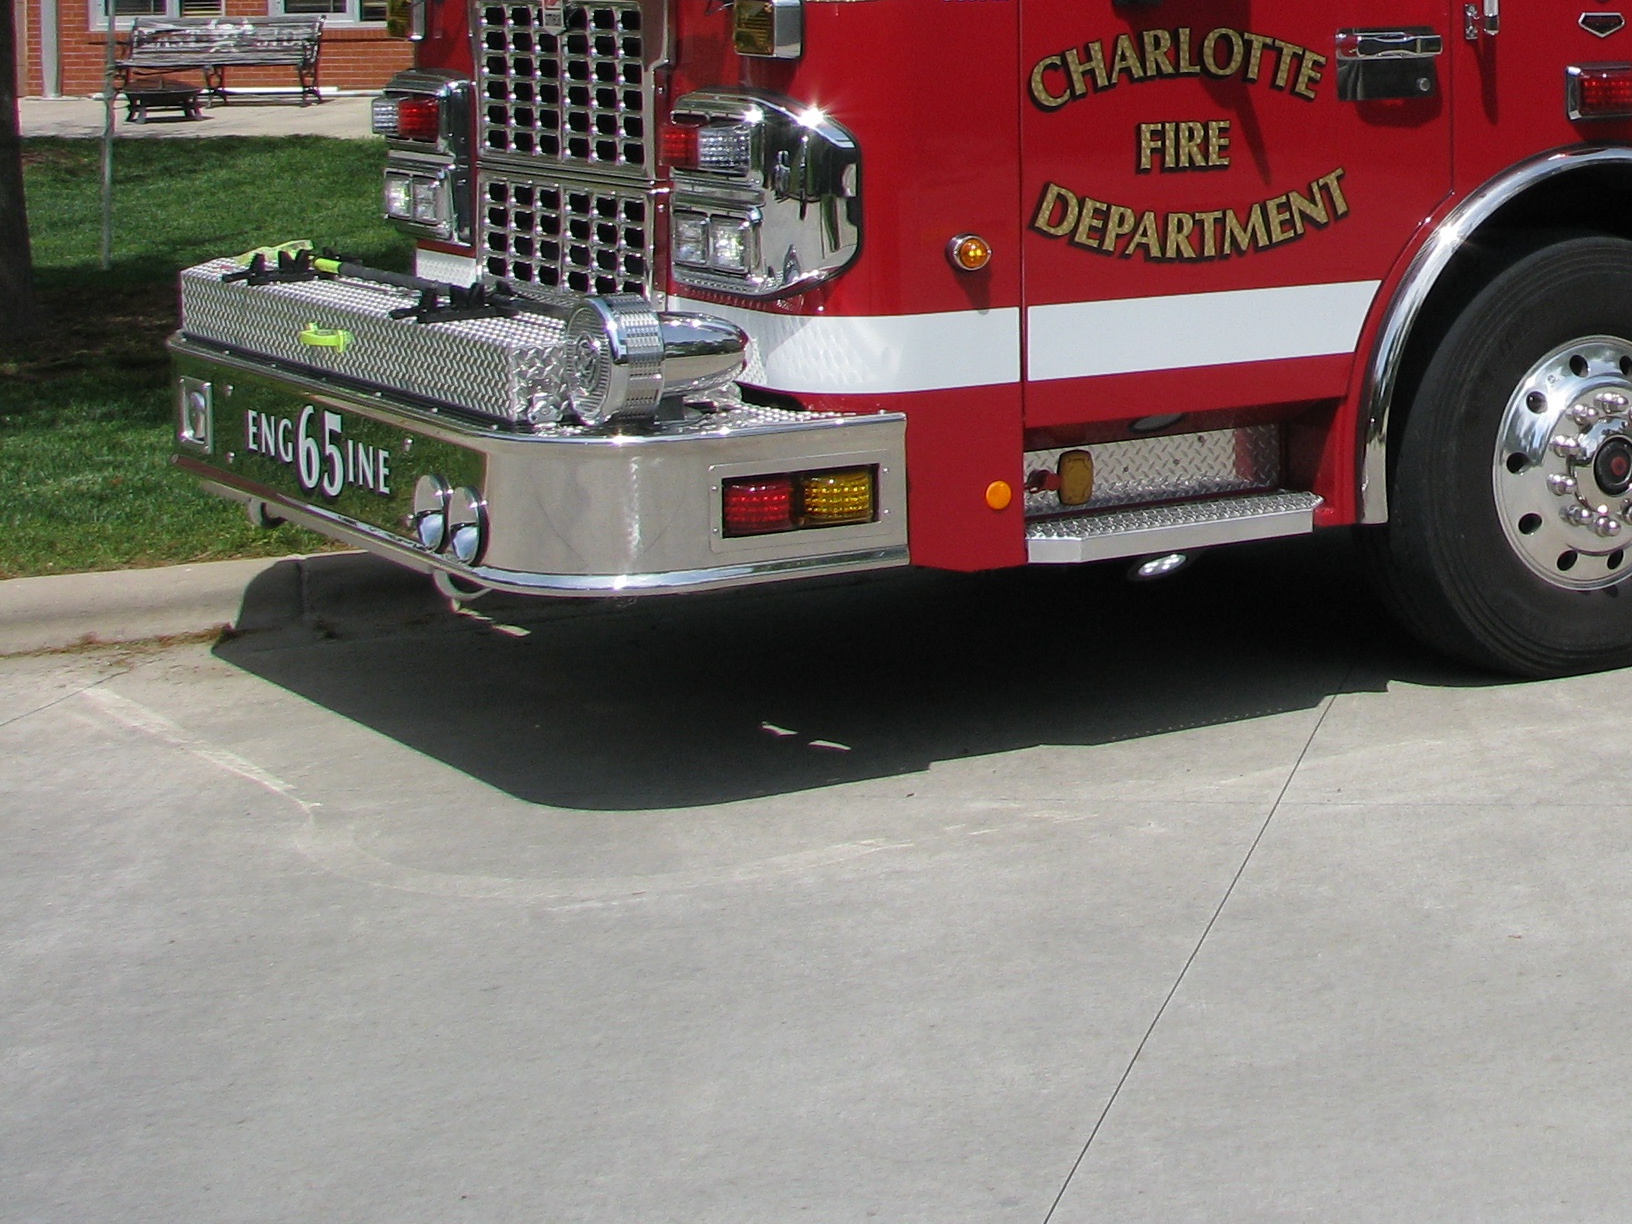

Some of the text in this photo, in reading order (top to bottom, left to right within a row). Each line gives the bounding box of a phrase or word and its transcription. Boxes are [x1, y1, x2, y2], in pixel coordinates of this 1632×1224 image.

[1028, 27, 1327, 112] CHARLOTTE
[1137, 119, 1231, 173] FIRE
[1028, 167, 1346, 263] DEPARTMENT
